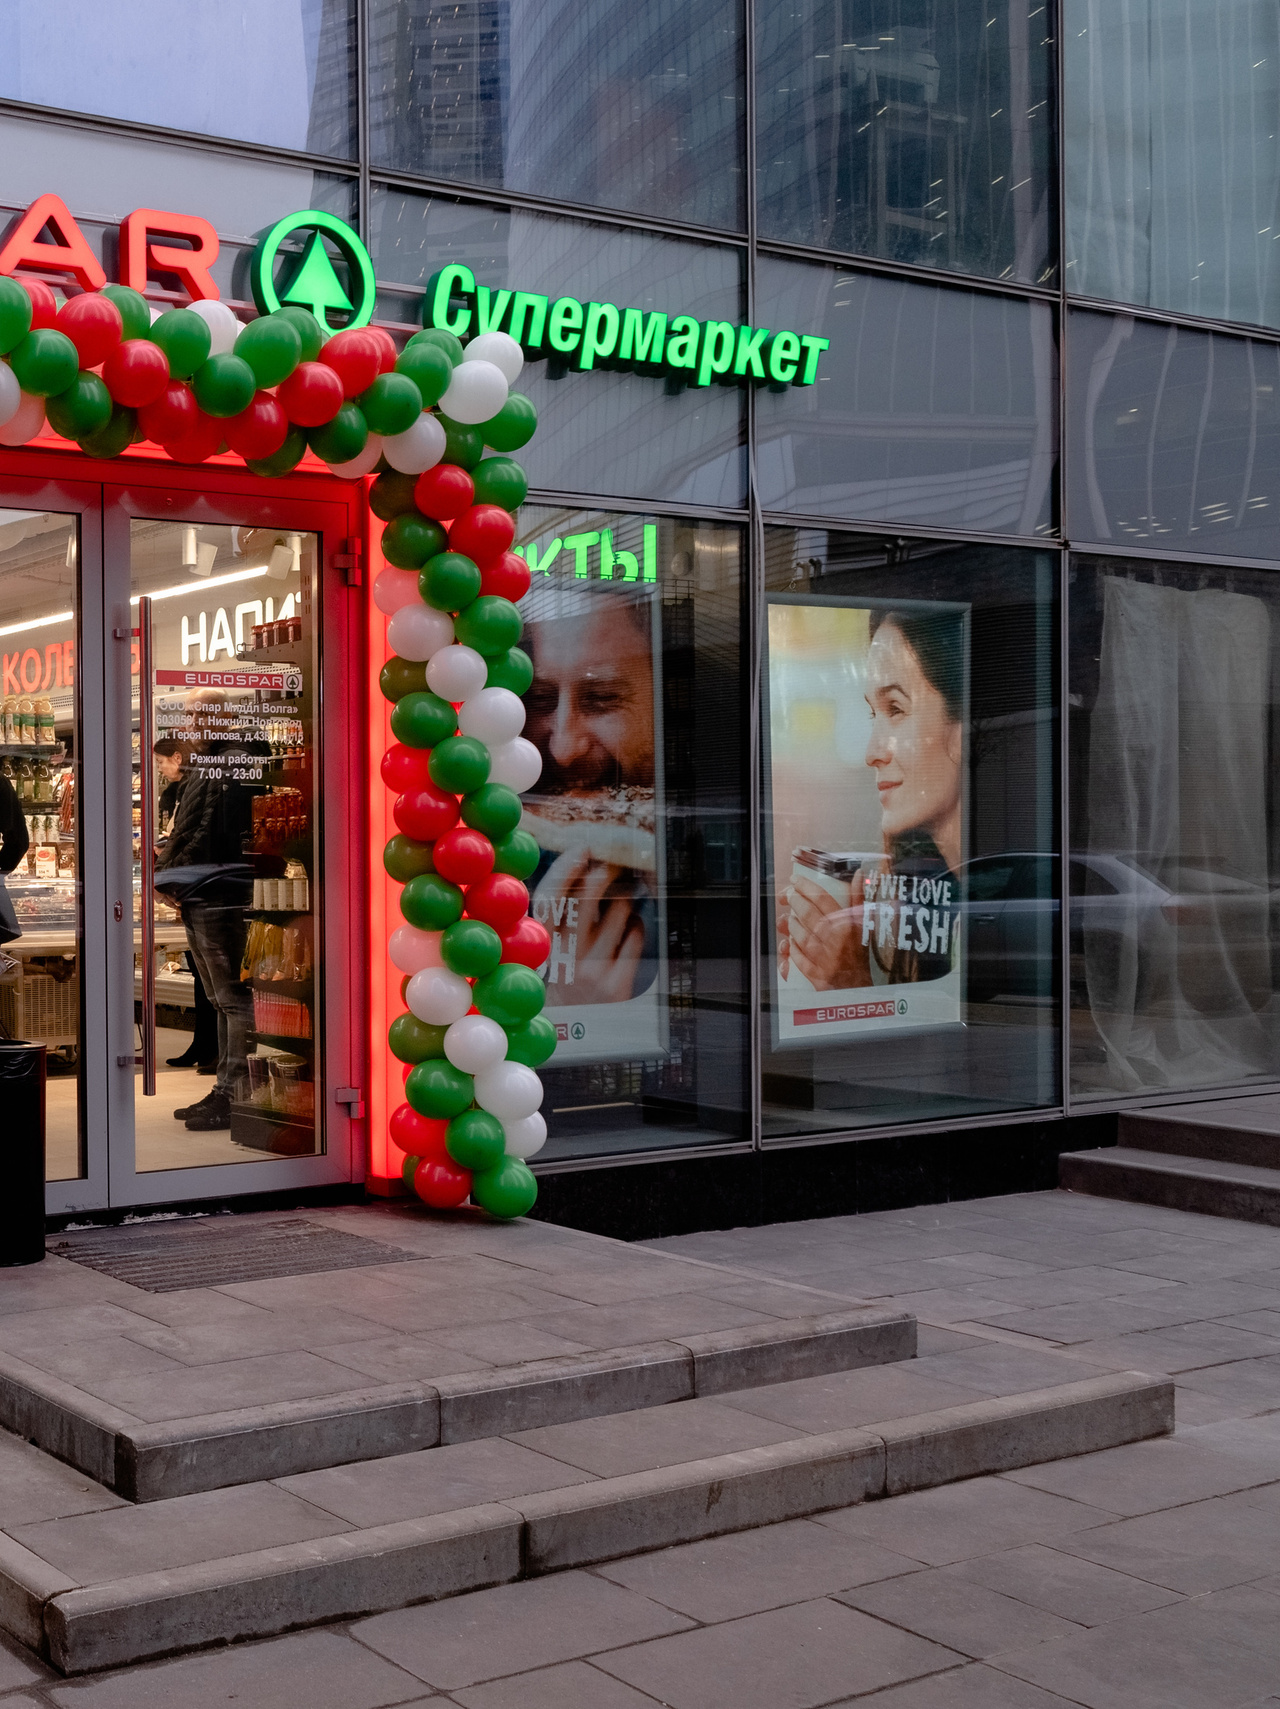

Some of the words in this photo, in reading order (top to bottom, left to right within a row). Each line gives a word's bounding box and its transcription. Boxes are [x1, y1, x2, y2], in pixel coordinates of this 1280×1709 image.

[426, 263, 830, 387] Супермаркет
[181, 591, 301, 666] НАПИ
[184, 673, 283, 687] EUROSPAR
[160, 701, 185, 711] ООО
[190, 701, 221, 714] «Спар
[224, 702, 260, 714] Миддл
[262, 702, 299, 714] Волга»
[198, 718, 205, 726] г.
[208, 716, 250, 727] Нижний
[155, 730, 170, 742] ул.
[173, 729, 201, 741] Героя
[204, 730, 243, 742] Попова,
[190, 753, 225, 764] Режим
[199, 768, 222, 780] 7.00
[913, 875, 952, 907] LOVE
[861, 901, 951, 955] FRESH
[816, 1003, 895, 1021] EUROSPAR
